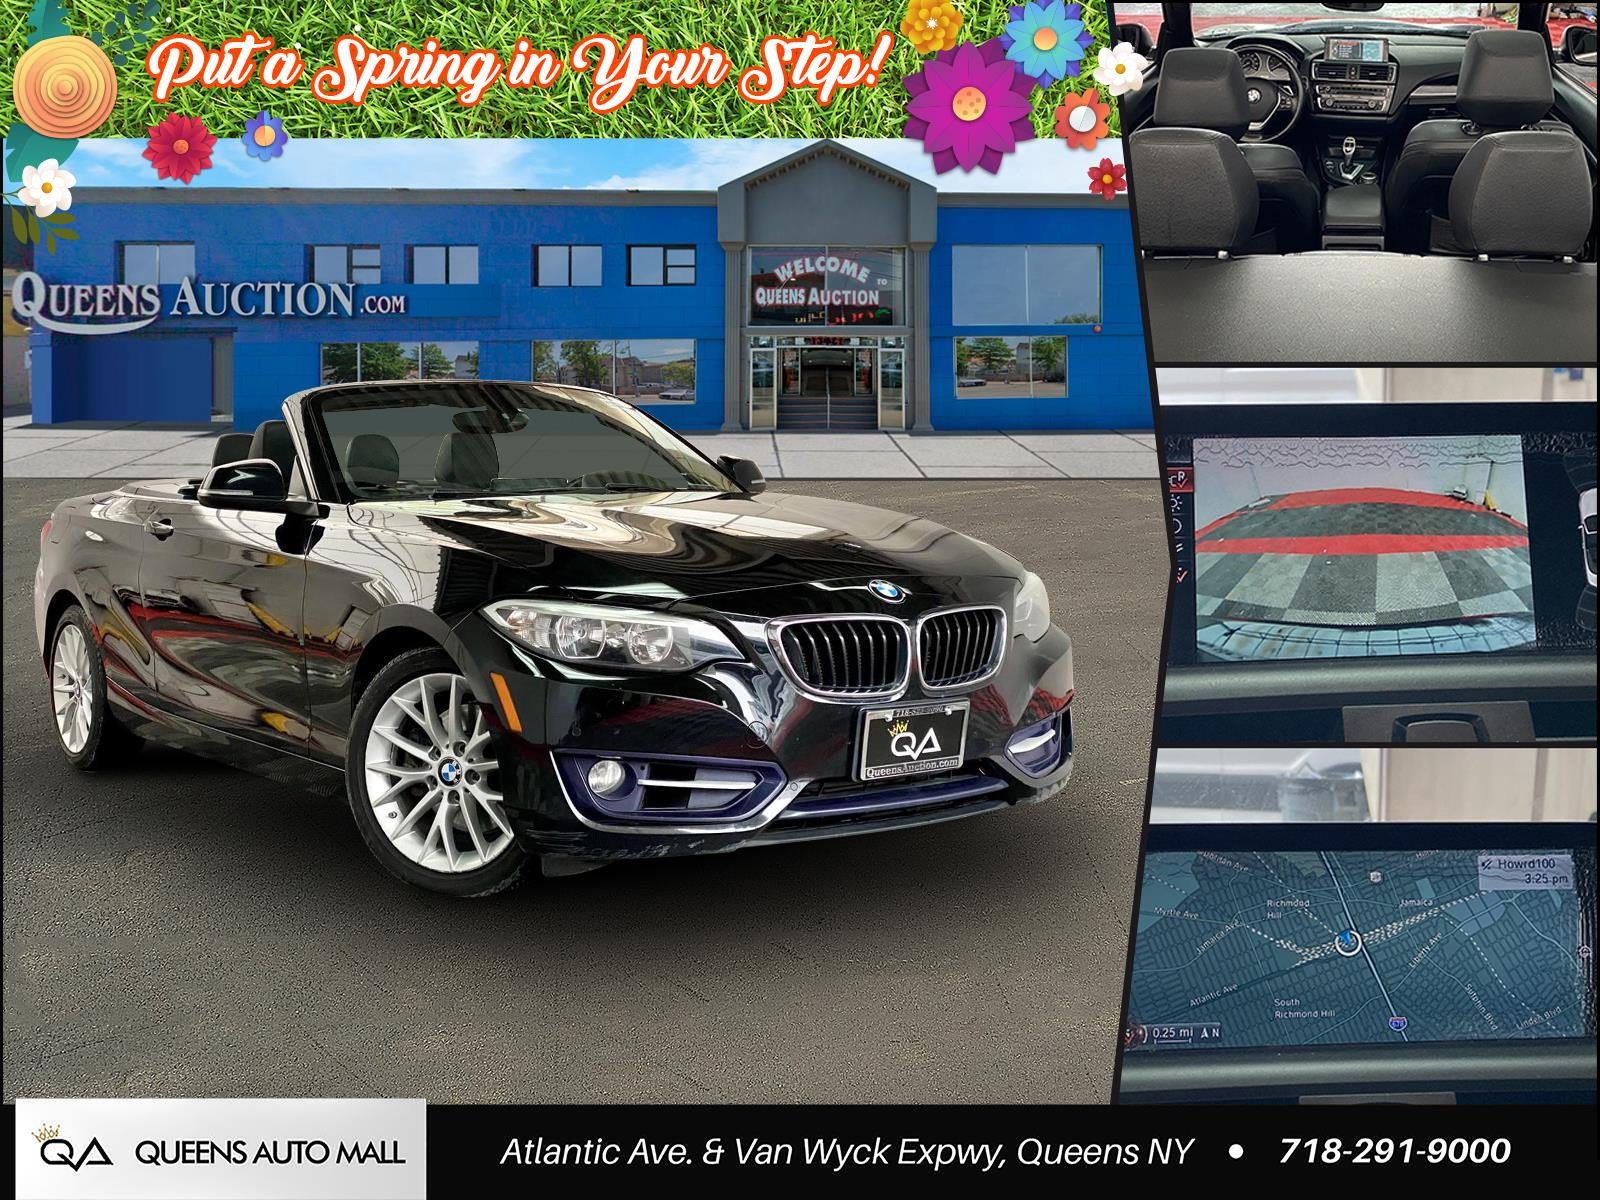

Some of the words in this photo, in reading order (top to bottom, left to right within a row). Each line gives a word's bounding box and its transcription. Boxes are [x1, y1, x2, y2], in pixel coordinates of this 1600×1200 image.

[773, 256, 871, 283] WELCOME
[877, 278, 888, 286] TO
[12, 270, 160, 336] QUEENS
[755, 286, 805, 307] QUEENS
[808, 287, 880, 305] AUCTION
[866, 758, 960, 778] QueensAuction.com
[1524, 873, 1549, 884] 3:25
[1552, 875, 1569, 885] pm
[1267, 911, 1282, 919] Hill
[1196, 930, 1225, 954] Jamaica
[1189, 990, 1222, 1007] Atlantic
[1222, 983, 1239, 994] Ave
[1274, 998, 1301, 1007] South
[1274, 1010, 1319, 1019] Richmond
[1320, 1009, 1336, 1018] Hill
[1152, 1027, 1176, 1038] 0.25
[1179, 1026, 1194, 1037] mi
